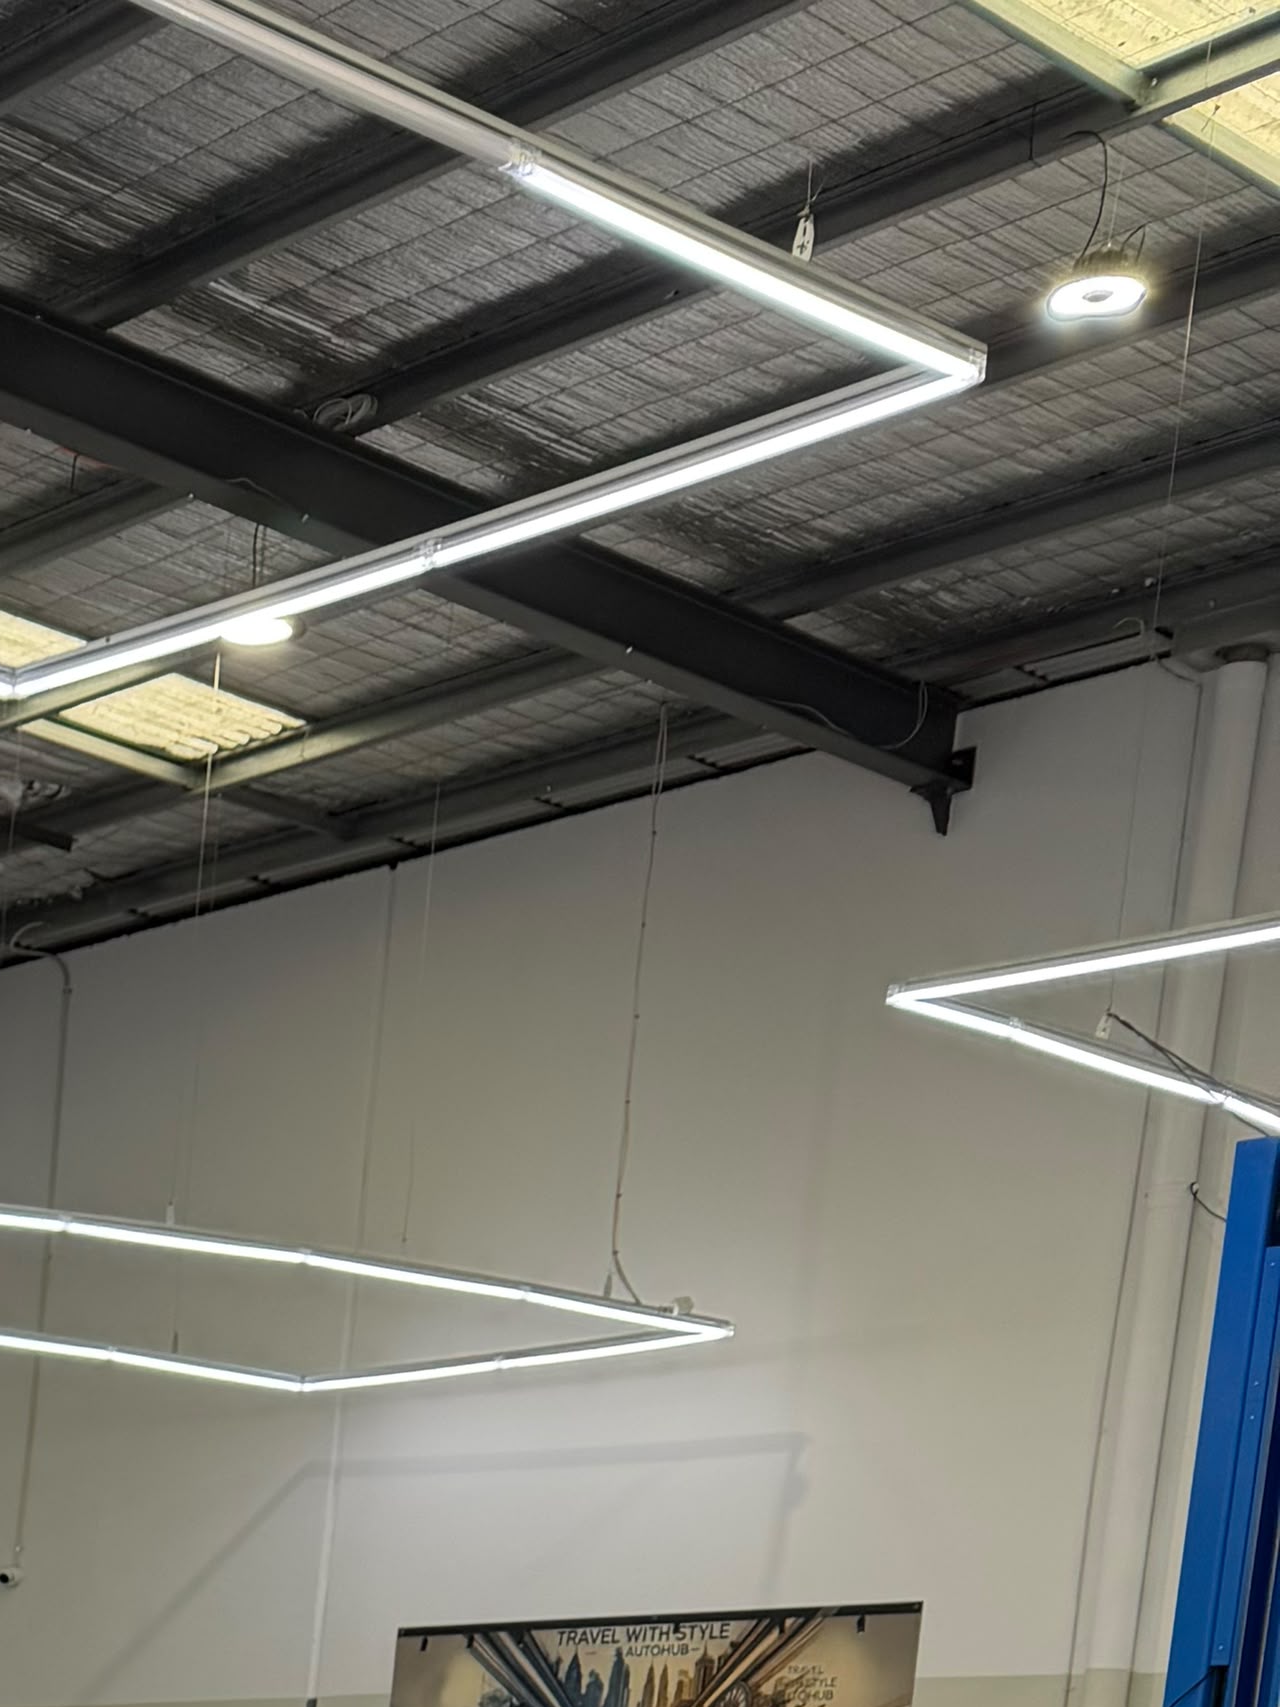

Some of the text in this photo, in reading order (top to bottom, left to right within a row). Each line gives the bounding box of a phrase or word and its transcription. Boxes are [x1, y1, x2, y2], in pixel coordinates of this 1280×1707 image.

[557, 1623, 732, 1647] TRAVEL WITH STYLE
[625, 1643, 690, 1658] AUTOHUB
